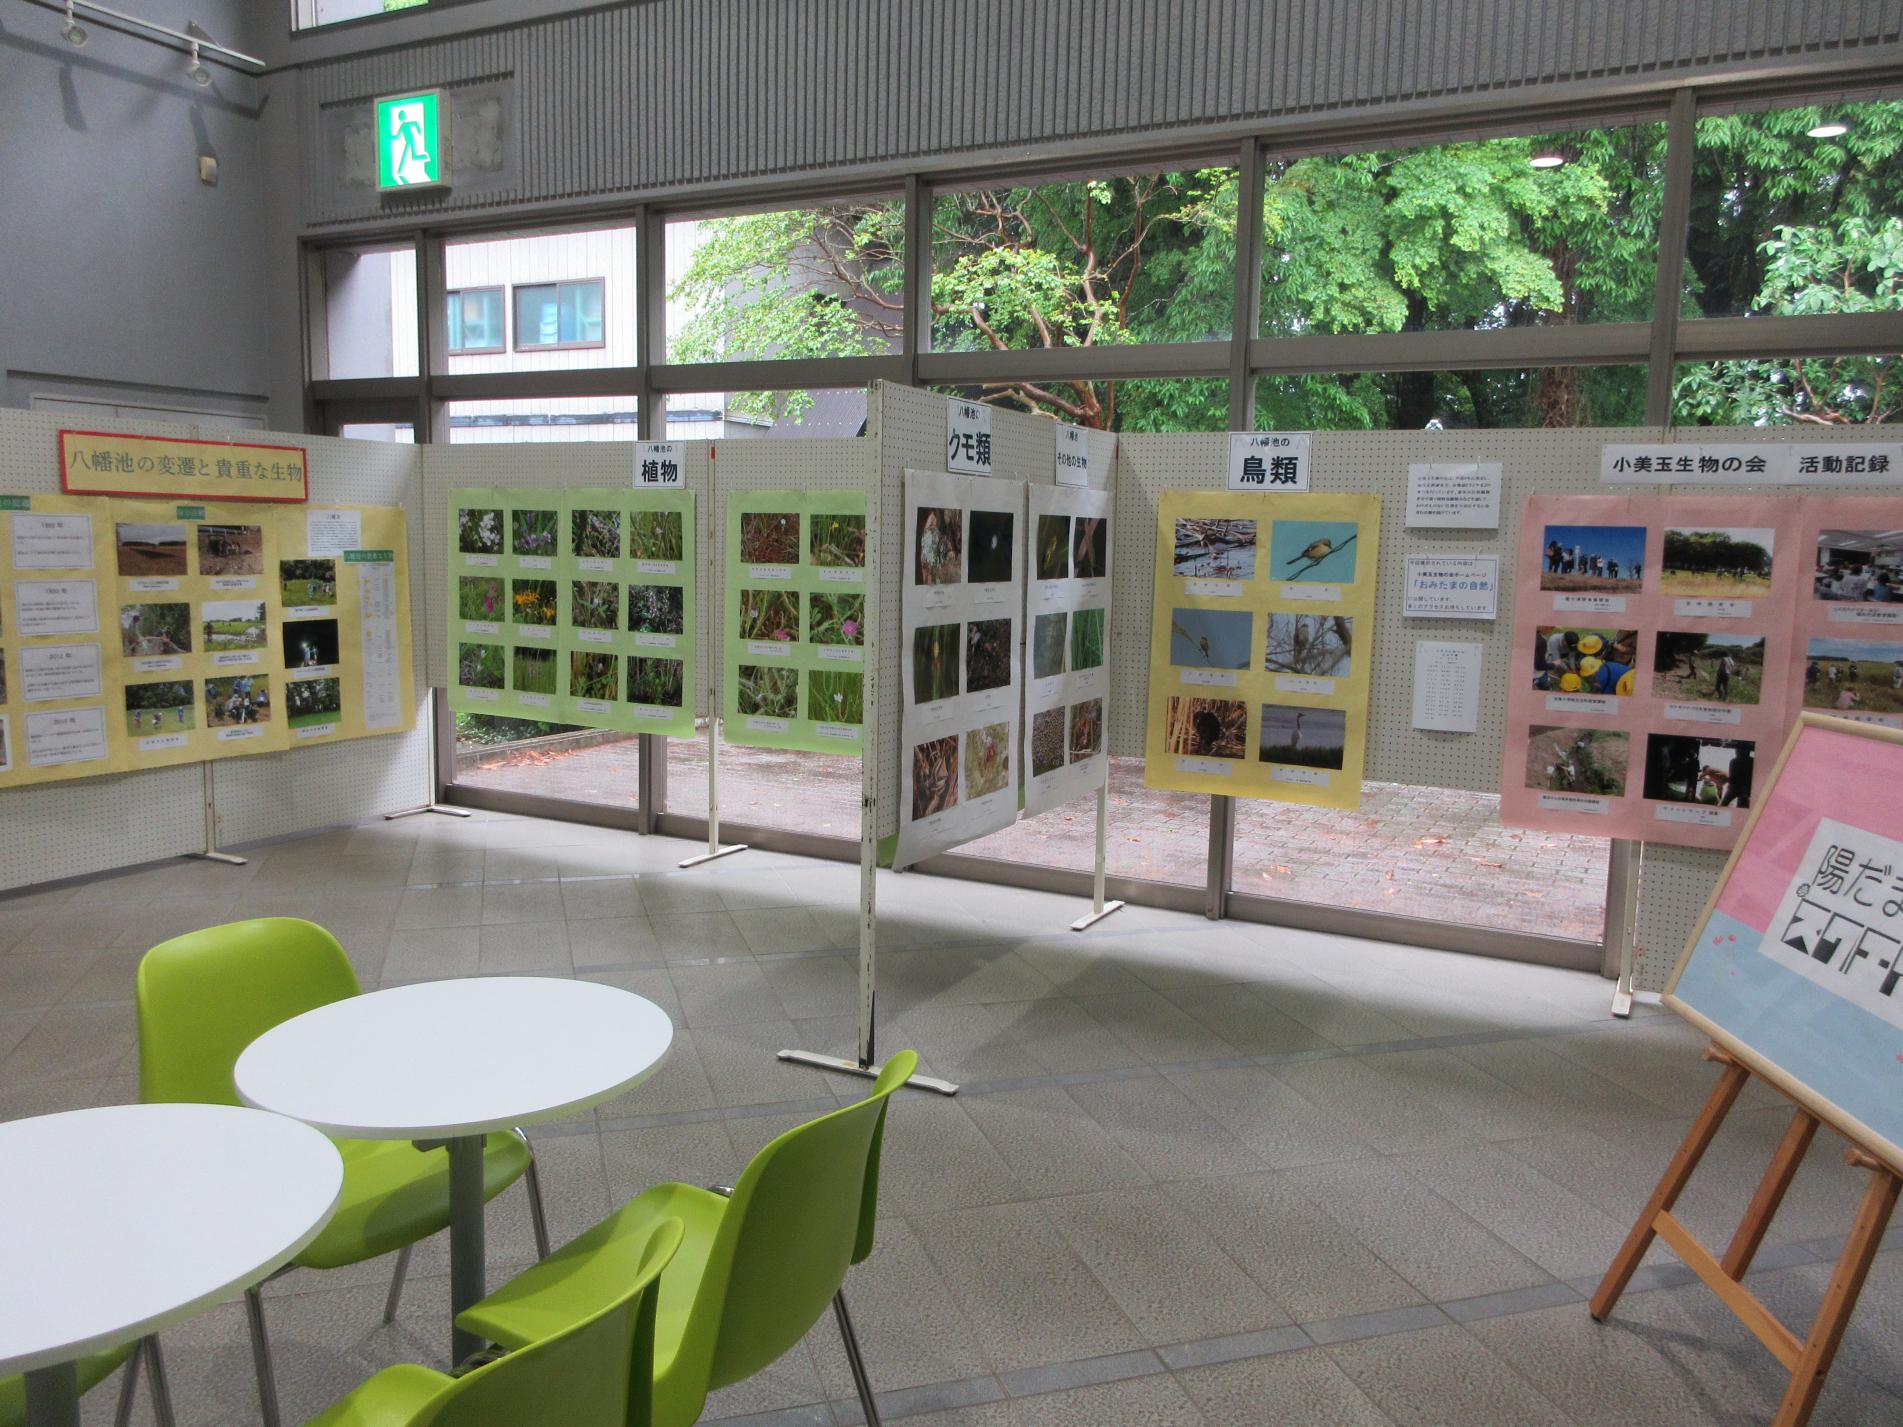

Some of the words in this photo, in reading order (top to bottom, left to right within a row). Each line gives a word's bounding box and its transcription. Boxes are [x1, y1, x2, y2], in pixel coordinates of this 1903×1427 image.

[647, 444, 673, 453] 八幡池の
[949, 428, 991, 466] クモ類
[1250, 437, 1290, 447] 八幡池の
[1057, 452, 1087, 469] その他の生物
[1240, 455, 1299, 484] 鳥類
[1612, 455, 1767, 473] 小美玉生物の会
[1799, 454, 1890, 473] 活動記録
[641, 459, 678, 483] 植物
